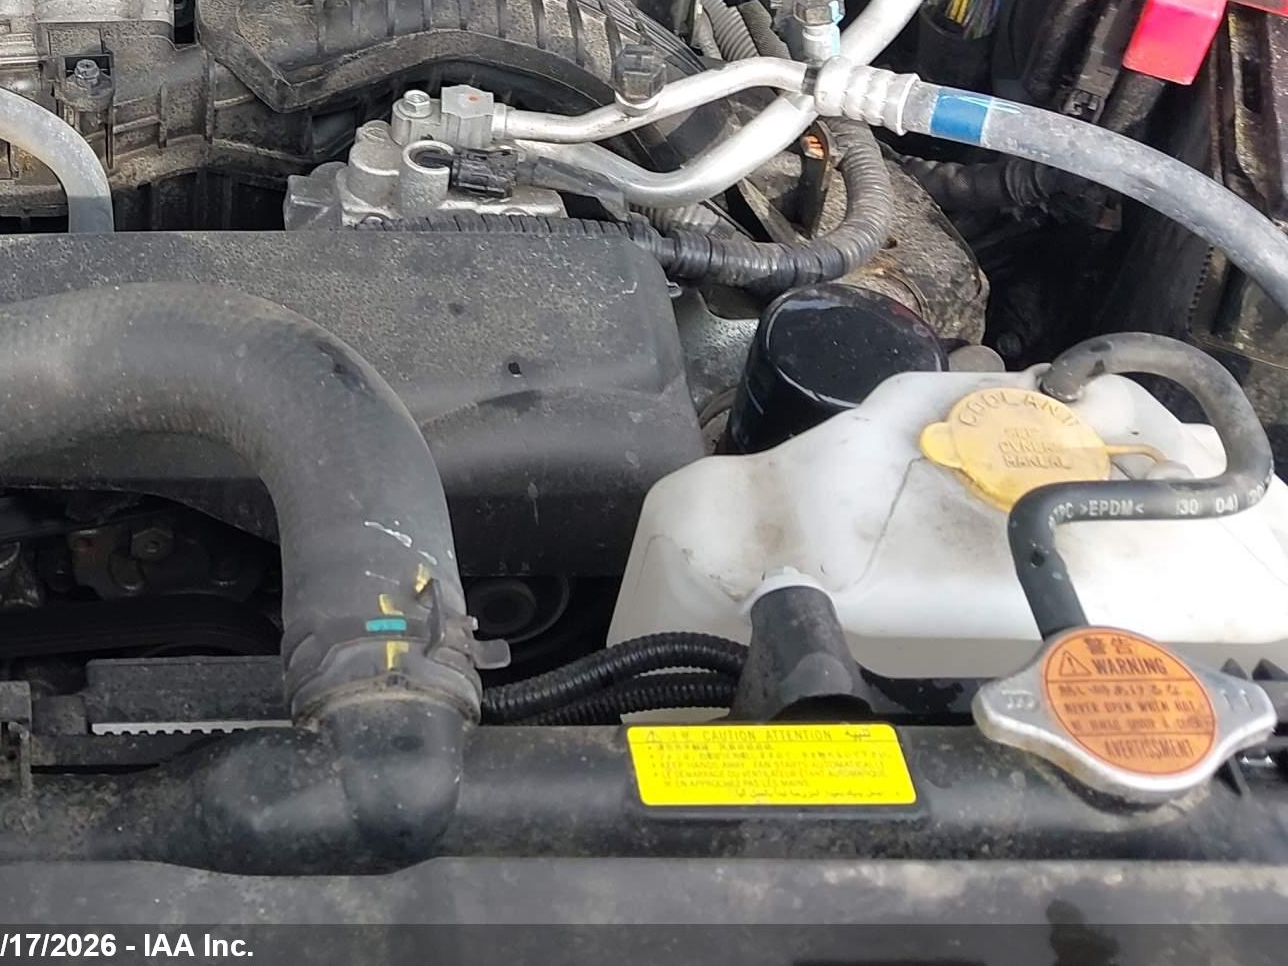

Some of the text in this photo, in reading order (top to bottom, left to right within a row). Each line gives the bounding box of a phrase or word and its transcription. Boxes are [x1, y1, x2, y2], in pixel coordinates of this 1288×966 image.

[958, 391, 1081, 427] COOLANT
[1001, 454, 1072, 470] MANUAL
[1092, 657, 1168, 676] WARNING
[1064, 699, 1196, 715] NEVER OPEN WHEN HOT
[703, 730, 757, 741] CAUTION
[765, 729, 833, 741] ATTENTION
